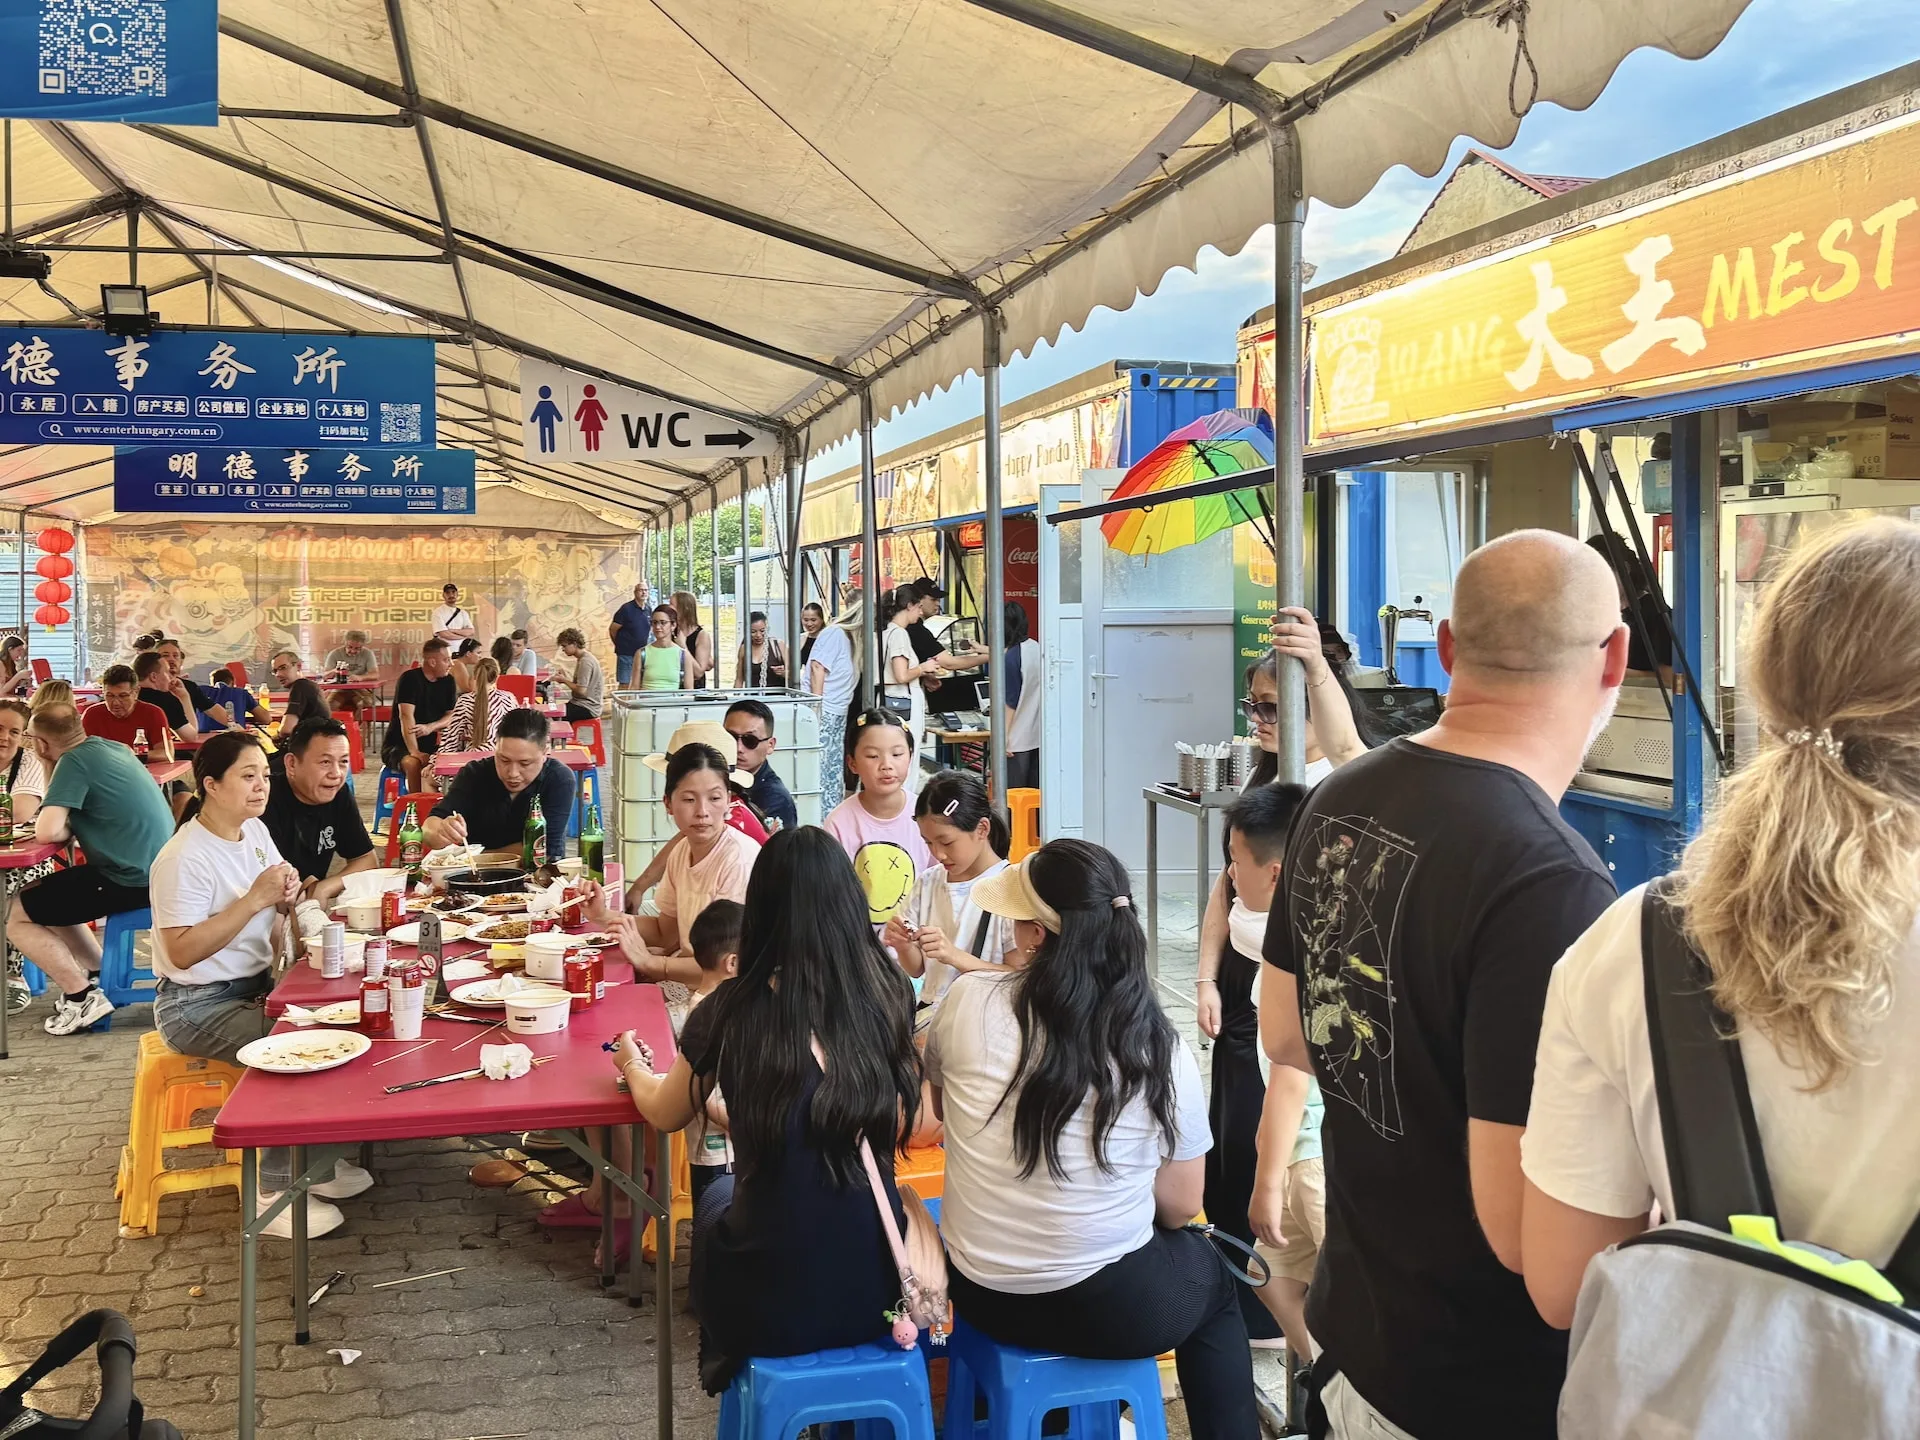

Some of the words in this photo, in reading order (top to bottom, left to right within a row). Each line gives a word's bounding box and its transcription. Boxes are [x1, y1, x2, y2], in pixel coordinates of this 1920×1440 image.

[1389, 315, 1506, 394] WANG
[1503, 234, 1707, 391] 大王
[1702, 196, 1919, 328] MEST
[20, 396, 57, 412] 永居
[83, 397, 119, 413] 入籍
[137, 399, 187, 414] 房产买卖
[198, 401, 247, 415] 公司做账
[258, 402, 307, 415] 企业落地
[318, 403, 366, 417] 个人落地
[73, 425, 218, 440] www.enterhungary.com.cn
[621, 412, 691, 449] WC
[1036, 438, 1070, 468] Panda
[168, 450, 424, 483] 明德事务所
[271, 535, 404, 560] Chinatown
[411, 536, 482, 560] Terasz
[290, 588, 384, 603] STREET
[267, 607, 353, 625] NIGHT
[422, 921, 439, 938] 31
